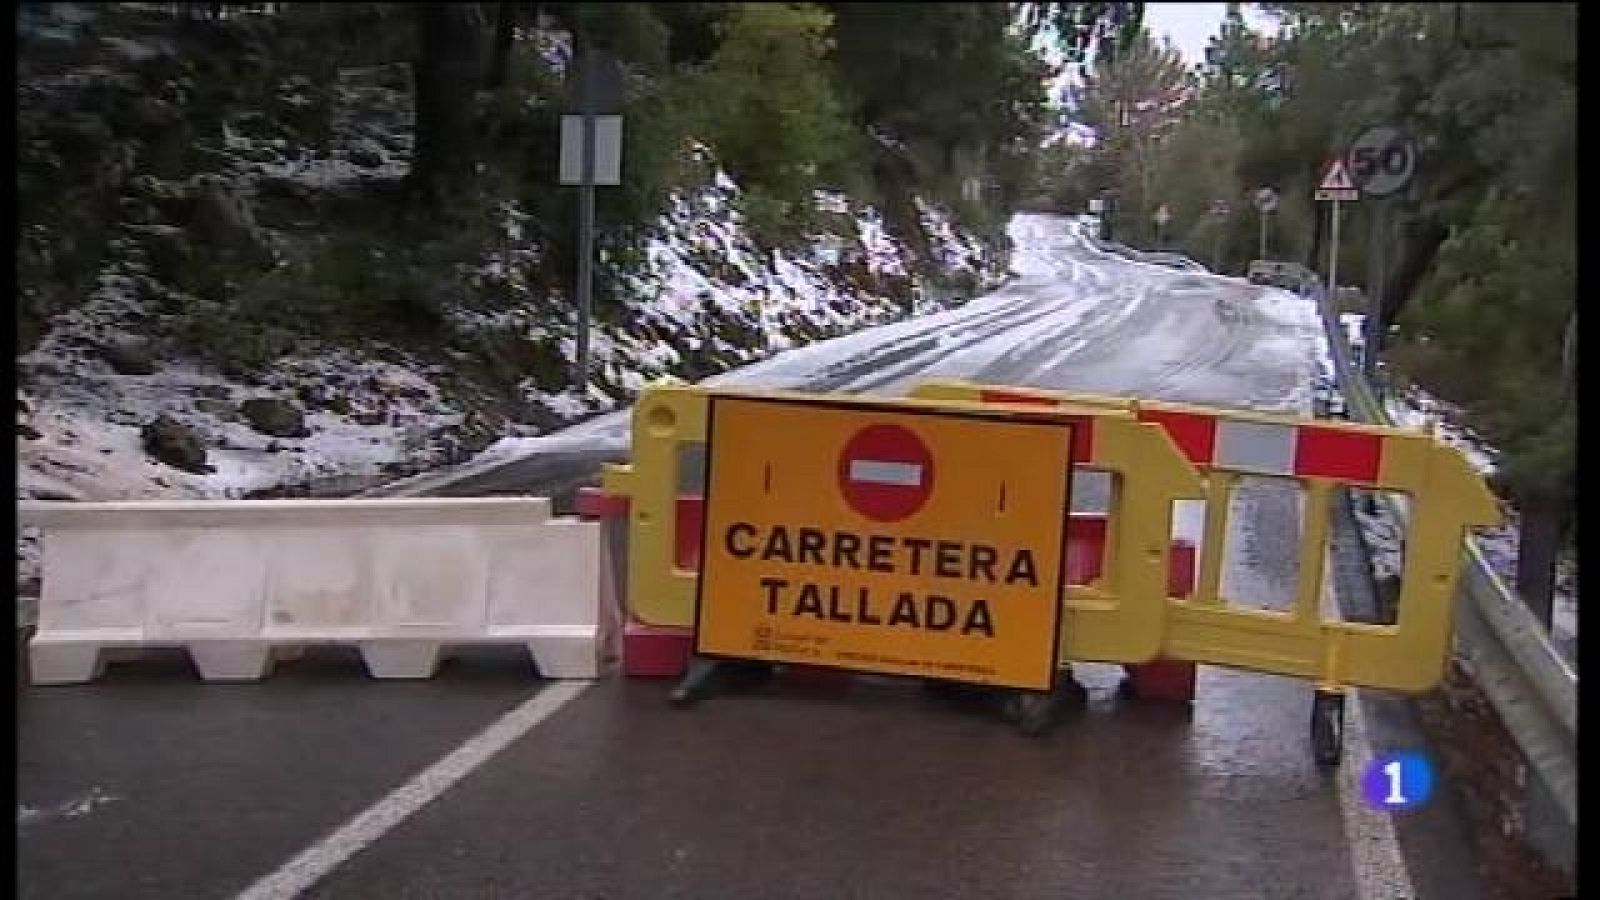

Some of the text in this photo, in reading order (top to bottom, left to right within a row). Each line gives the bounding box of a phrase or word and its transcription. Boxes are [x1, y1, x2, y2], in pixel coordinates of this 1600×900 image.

[1354, 144, 1407, 176] 50
[724, 522, 1039, 587] CARRETERA
[760, 577, 995, 638] TALLADA
